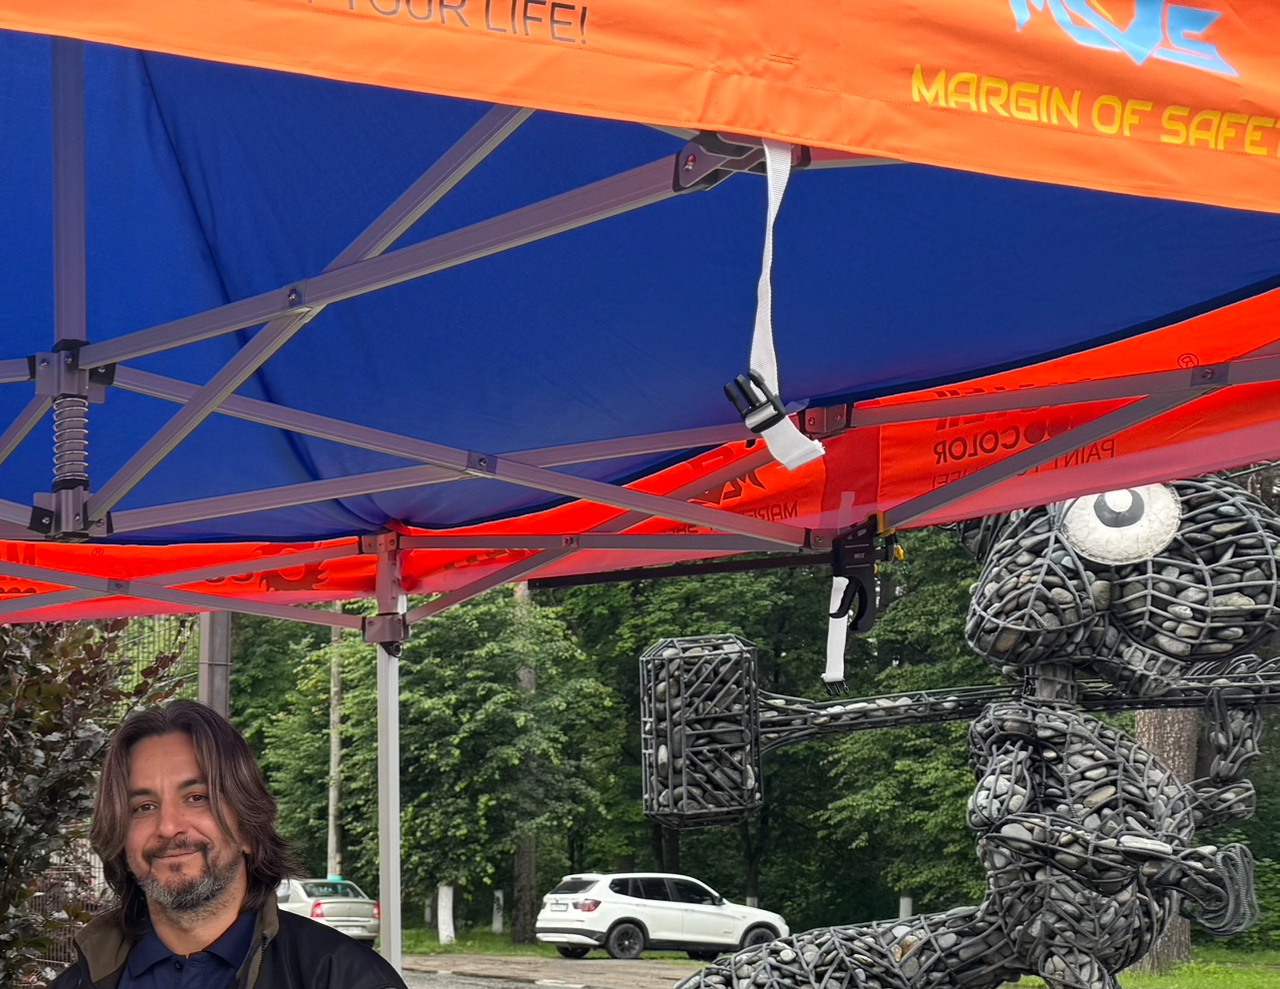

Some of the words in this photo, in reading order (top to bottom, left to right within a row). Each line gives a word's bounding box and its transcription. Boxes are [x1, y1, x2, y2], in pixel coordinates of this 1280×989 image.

[484, 0, 588, 44] LIFE!
[911, 64, 1081, 128] MARGIN
[1091, 95, 1153, 136] OF
[1160, 105, 1280, 158] SAFE
